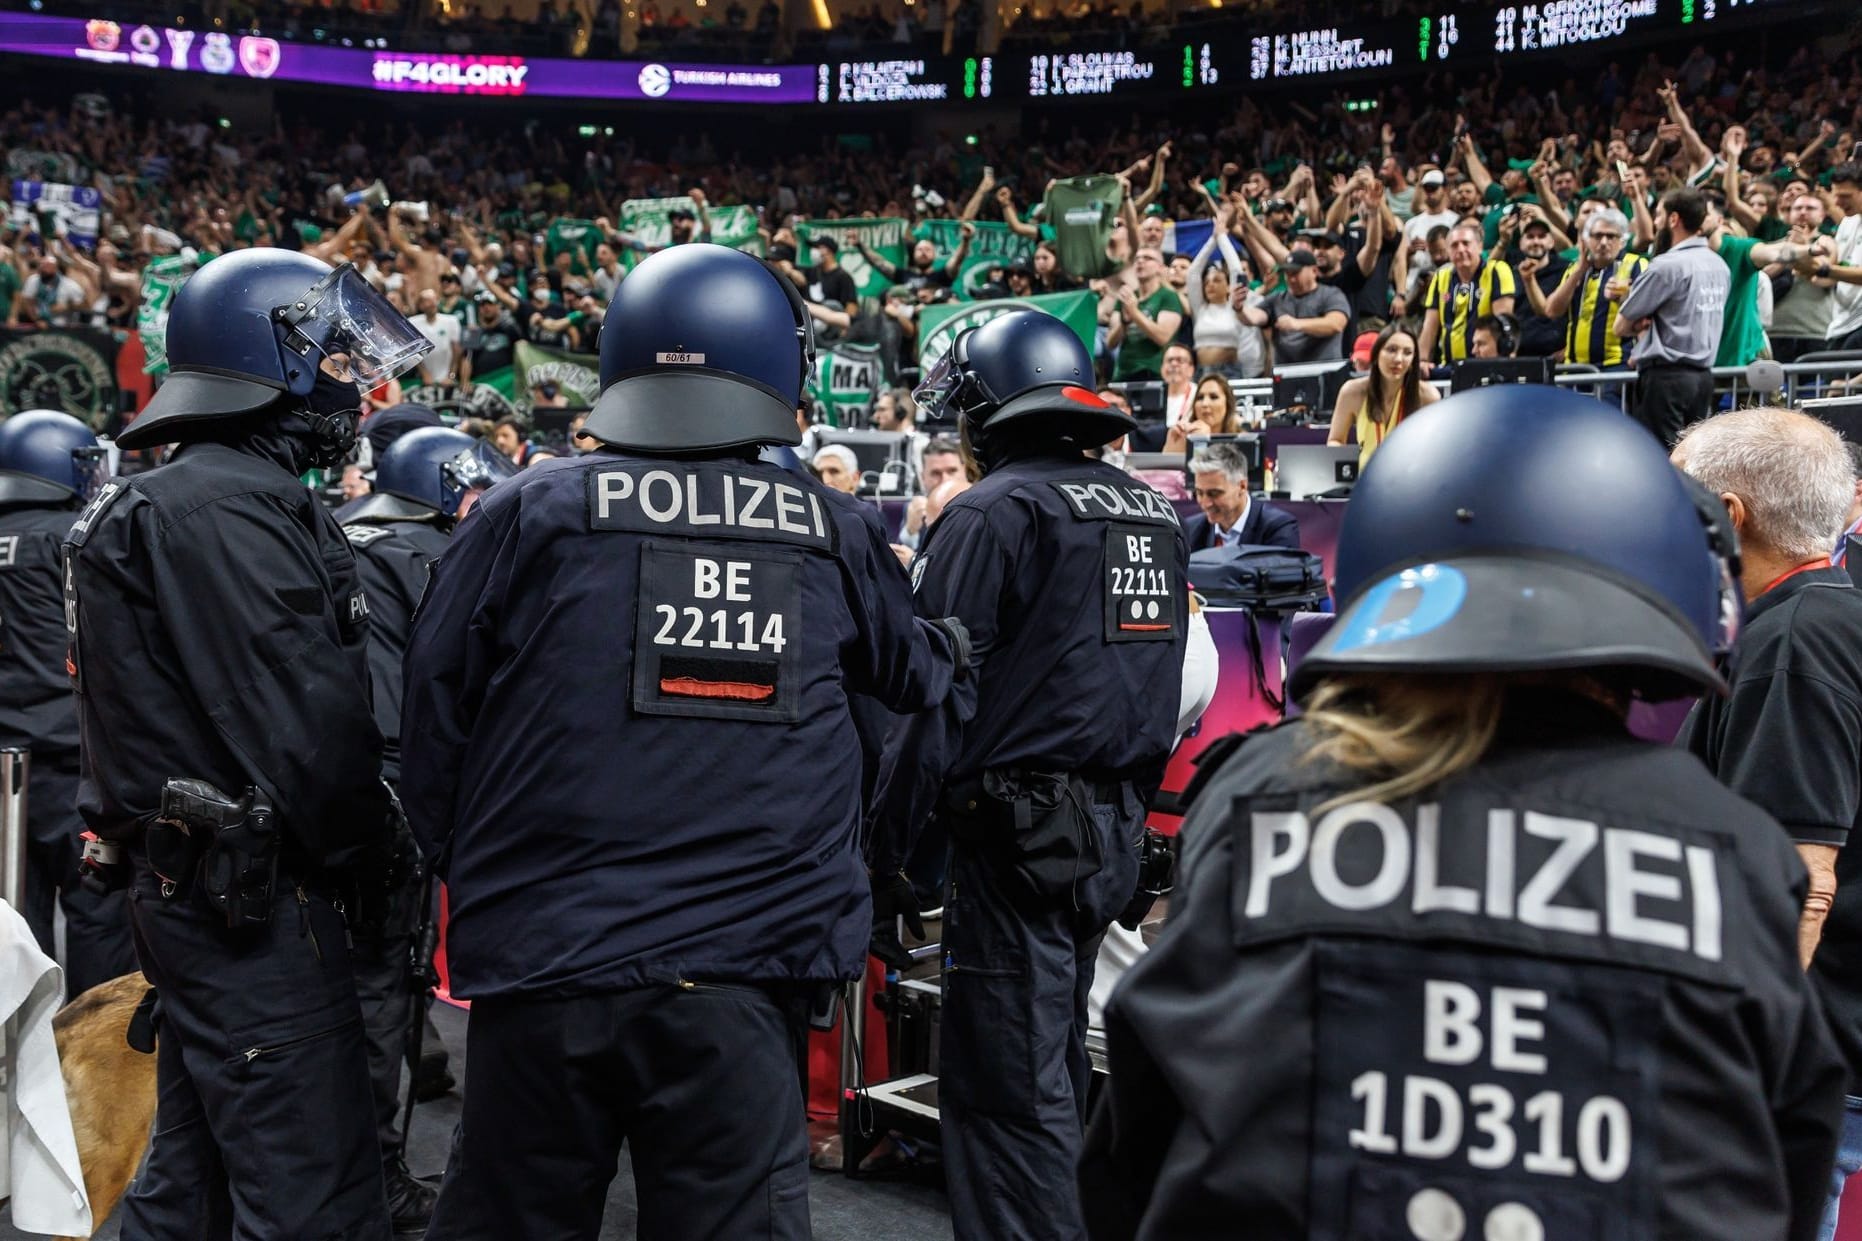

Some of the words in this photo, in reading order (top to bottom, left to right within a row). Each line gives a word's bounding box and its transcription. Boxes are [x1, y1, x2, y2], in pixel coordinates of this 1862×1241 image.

[372, 59, 528, 87] #F4GLORY
[673, 70, 726, 85] TURKISH
[727, 72, 781, 87] AIRLINES
[665, 353, 691, 363] 60/61
[597, 470, 826, 538] POLIZEI
[1060, 483, 1180, 527] POLIZEI
[1126, 535, 1153, 563] BE
[693, 558, 751, 601] BE
[1111, 568, 1169, 596] 22111
[653, 604, 786, 653] 22114
[1245, 801, 1722, 961] POLIZEI
[1424, 979, 1548, 1074] BE
[1349, 1071, 1632, 1183] 1D310
